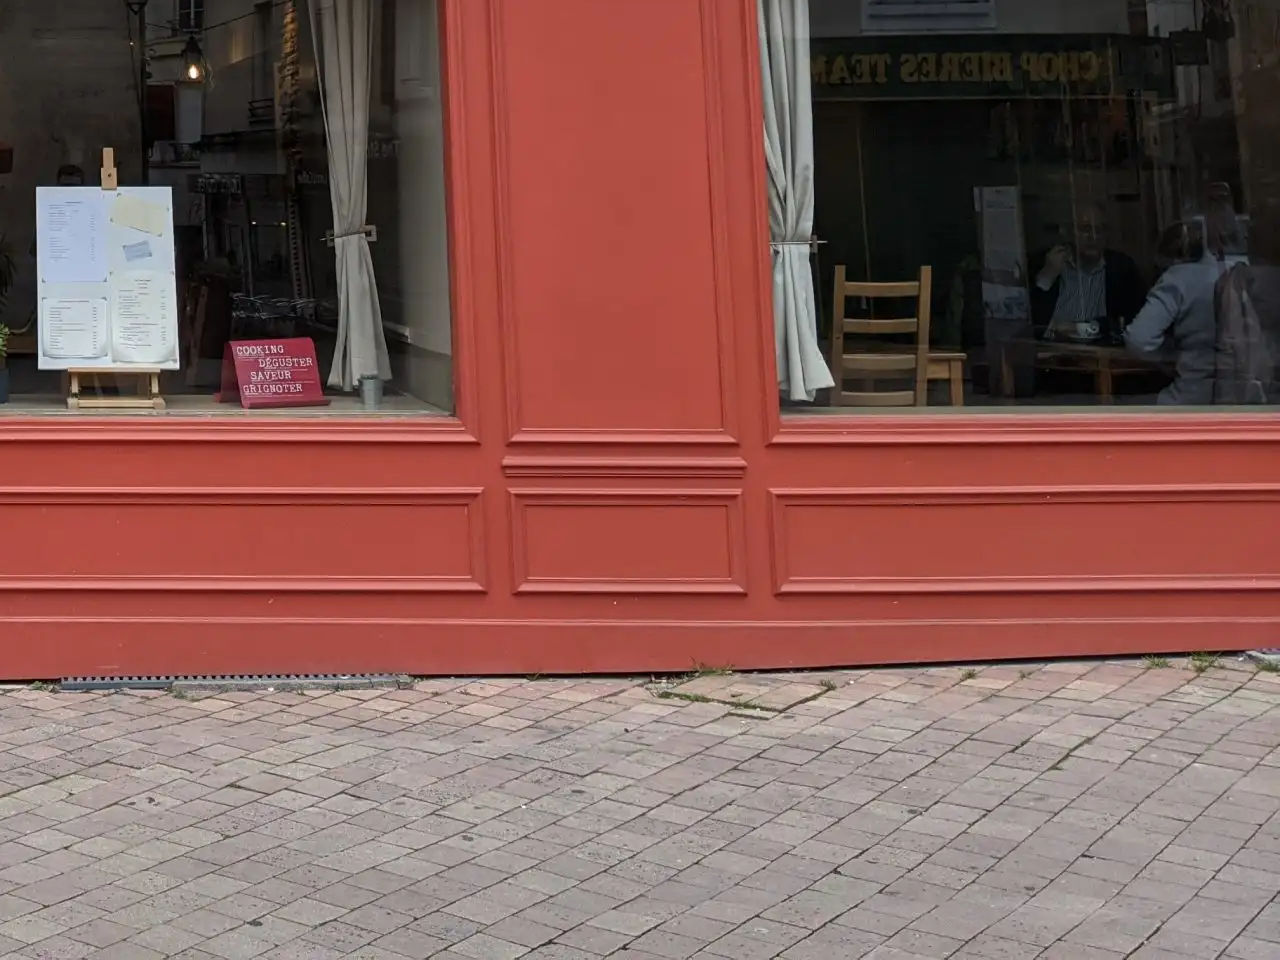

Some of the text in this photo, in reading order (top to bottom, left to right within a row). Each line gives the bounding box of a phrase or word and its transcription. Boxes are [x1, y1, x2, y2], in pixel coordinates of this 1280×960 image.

[236, 345, 284, 355] COOKING
[259, 357, 313, 368] DÉGUSTER
[250, 370, 291, 380] SAVEUR
[243, 383, 303, 394] GRIGNOTER
